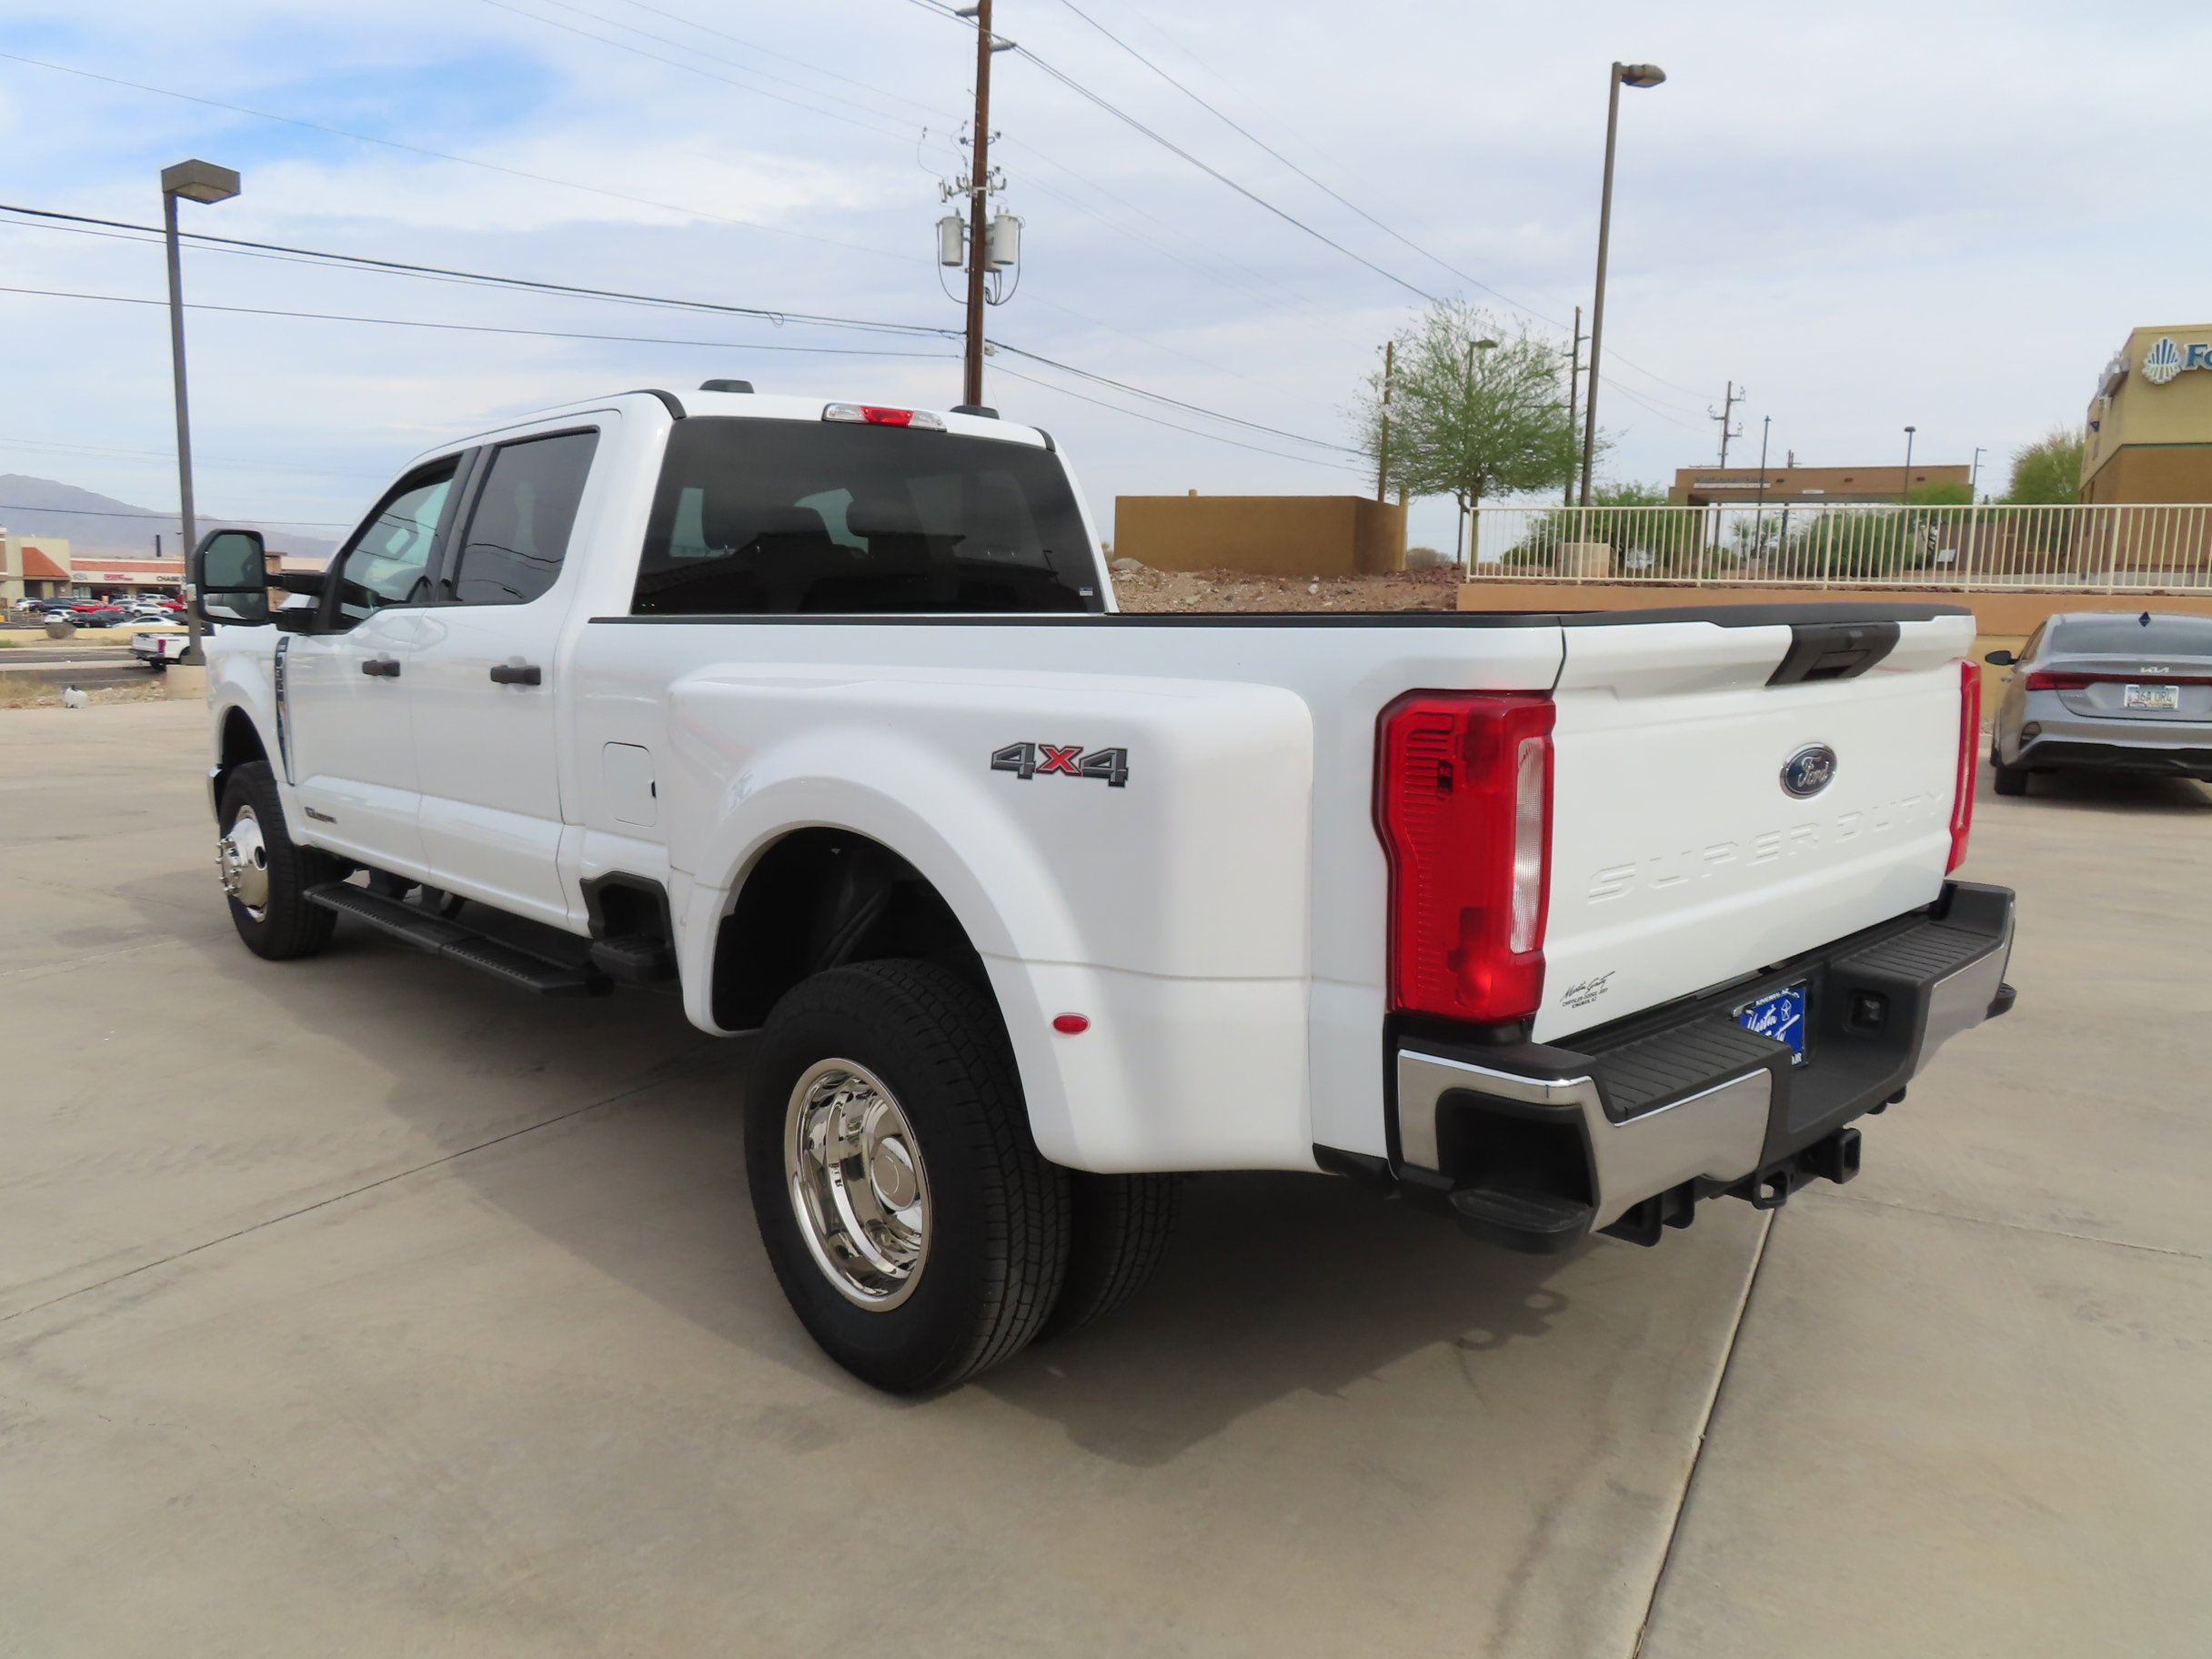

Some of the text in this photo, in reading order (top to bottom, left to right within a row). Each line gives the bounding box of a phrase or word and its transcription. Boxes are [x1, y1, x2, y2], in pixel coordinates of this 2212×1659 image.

[156, 575, 179, 583] CHASE
[1796, 756, 1830, 788] Ford
[1587, 790, 1944, 906] SUPER DUTY
